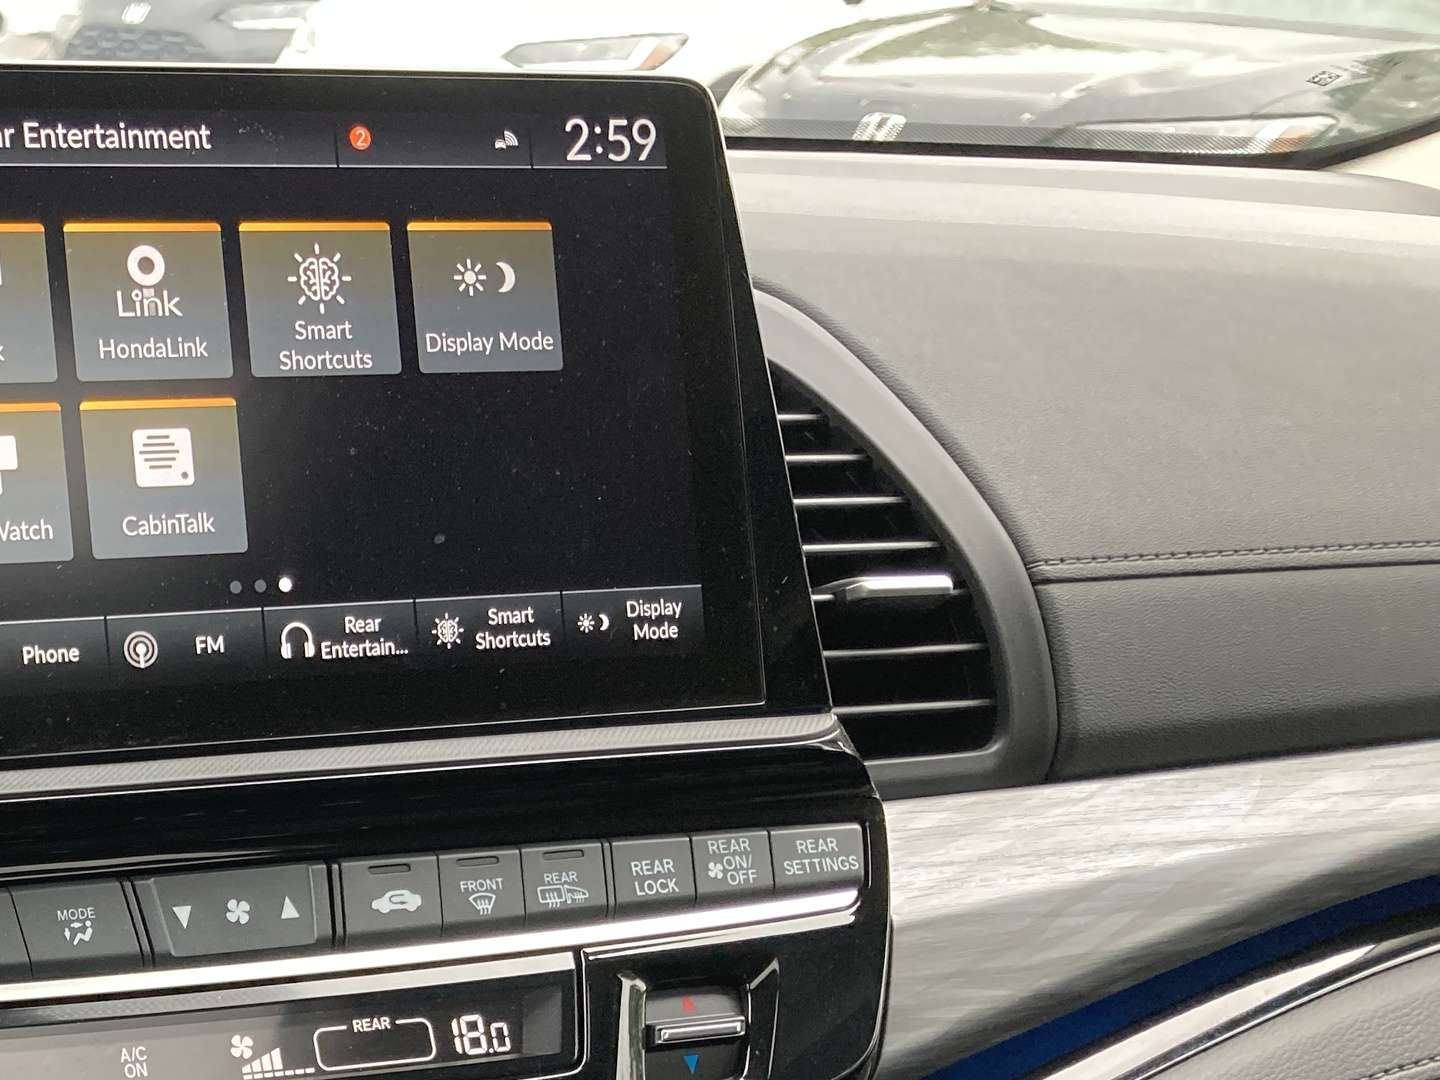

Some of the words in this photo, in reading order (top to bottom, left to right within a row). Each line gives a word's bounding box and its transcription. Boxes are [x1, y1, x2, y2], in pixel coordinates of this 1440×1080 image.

[24, 122, 211, 151] Entertainment
[355, 130, 365, 146] 2
[565, 118, 656, 161] 2:59
[117, 289, 182, 317] Link
[295, 320, 352, 341] Smart
[99, 337, 208, 360] HondaLink
[426, 332, 494, 354] Display
[499, 331, 553, 351] Mode
[279, 350, 373, 370] Shortcuts
[122, 513, 215, 537] CabinTalk
[488, 607, 534, 625] Smart
[626, 599, 682, 619] Display
[344, 615, 380, 633] Rear
[633, 622, 678, 640] Mode
[196, 635, 224, 654] FM
[321, 637, 408, 659] Entertain...
[475, 630, 550, 649] Shortcuts
[23, 645, 79, 665] Phone
[707, 837, 751, 855] REAR
[796, 837, 838, 855] REAR
[631, 858, 674, 877] REAR
[723, 853, 753, 870] ON/
[783, 855, 859, 875] SETTINGS
[460, 877, 503, 892] FRONT
[544, 870, 577, 885] REAR
[727, 867, 757, 885] OFF
[634, 877, 679, 896] LOCK
[57, 906, 96, 921] MODE
[353, 1016, 391, 1033] REAR
[451, 1014, 511, 1055] 18.0
[120, 1046, 147, 1063] A/C
[124, 1063, 148, 1078] ON
